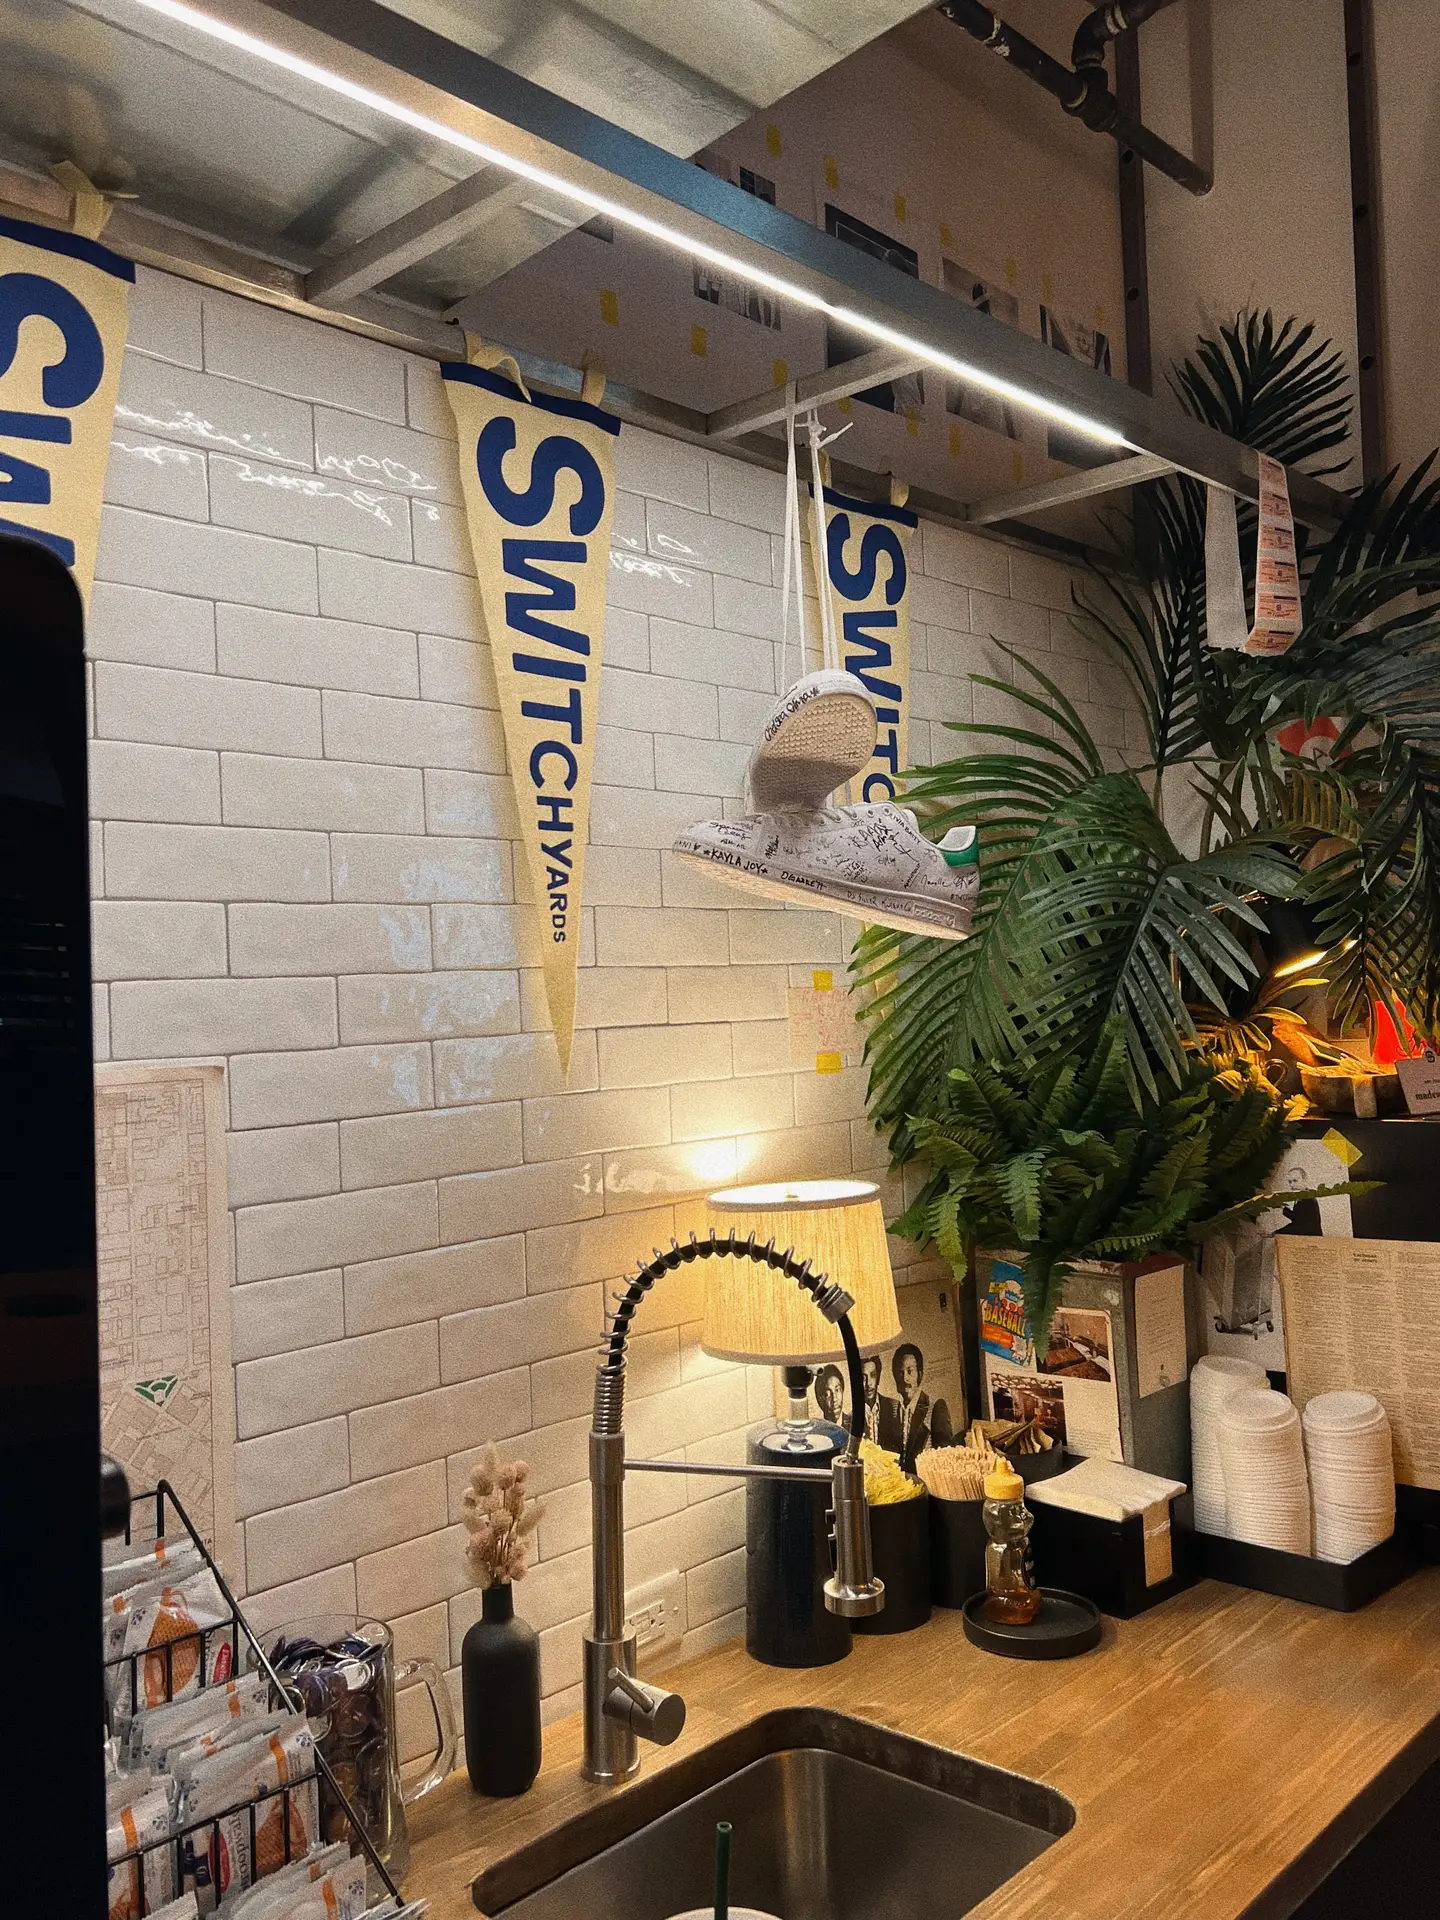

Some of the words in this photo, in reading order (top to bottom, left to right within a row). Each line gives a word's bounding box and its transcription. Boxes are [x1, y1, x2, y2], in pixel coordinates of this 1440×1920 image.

[476, 416, 606, 943] SWITCHYARDS
[710, 848, 742, 867] KAYLA
[743, 860, 766, 875] JOY
[984, 1303, 1027, 1337] BASEBALL
